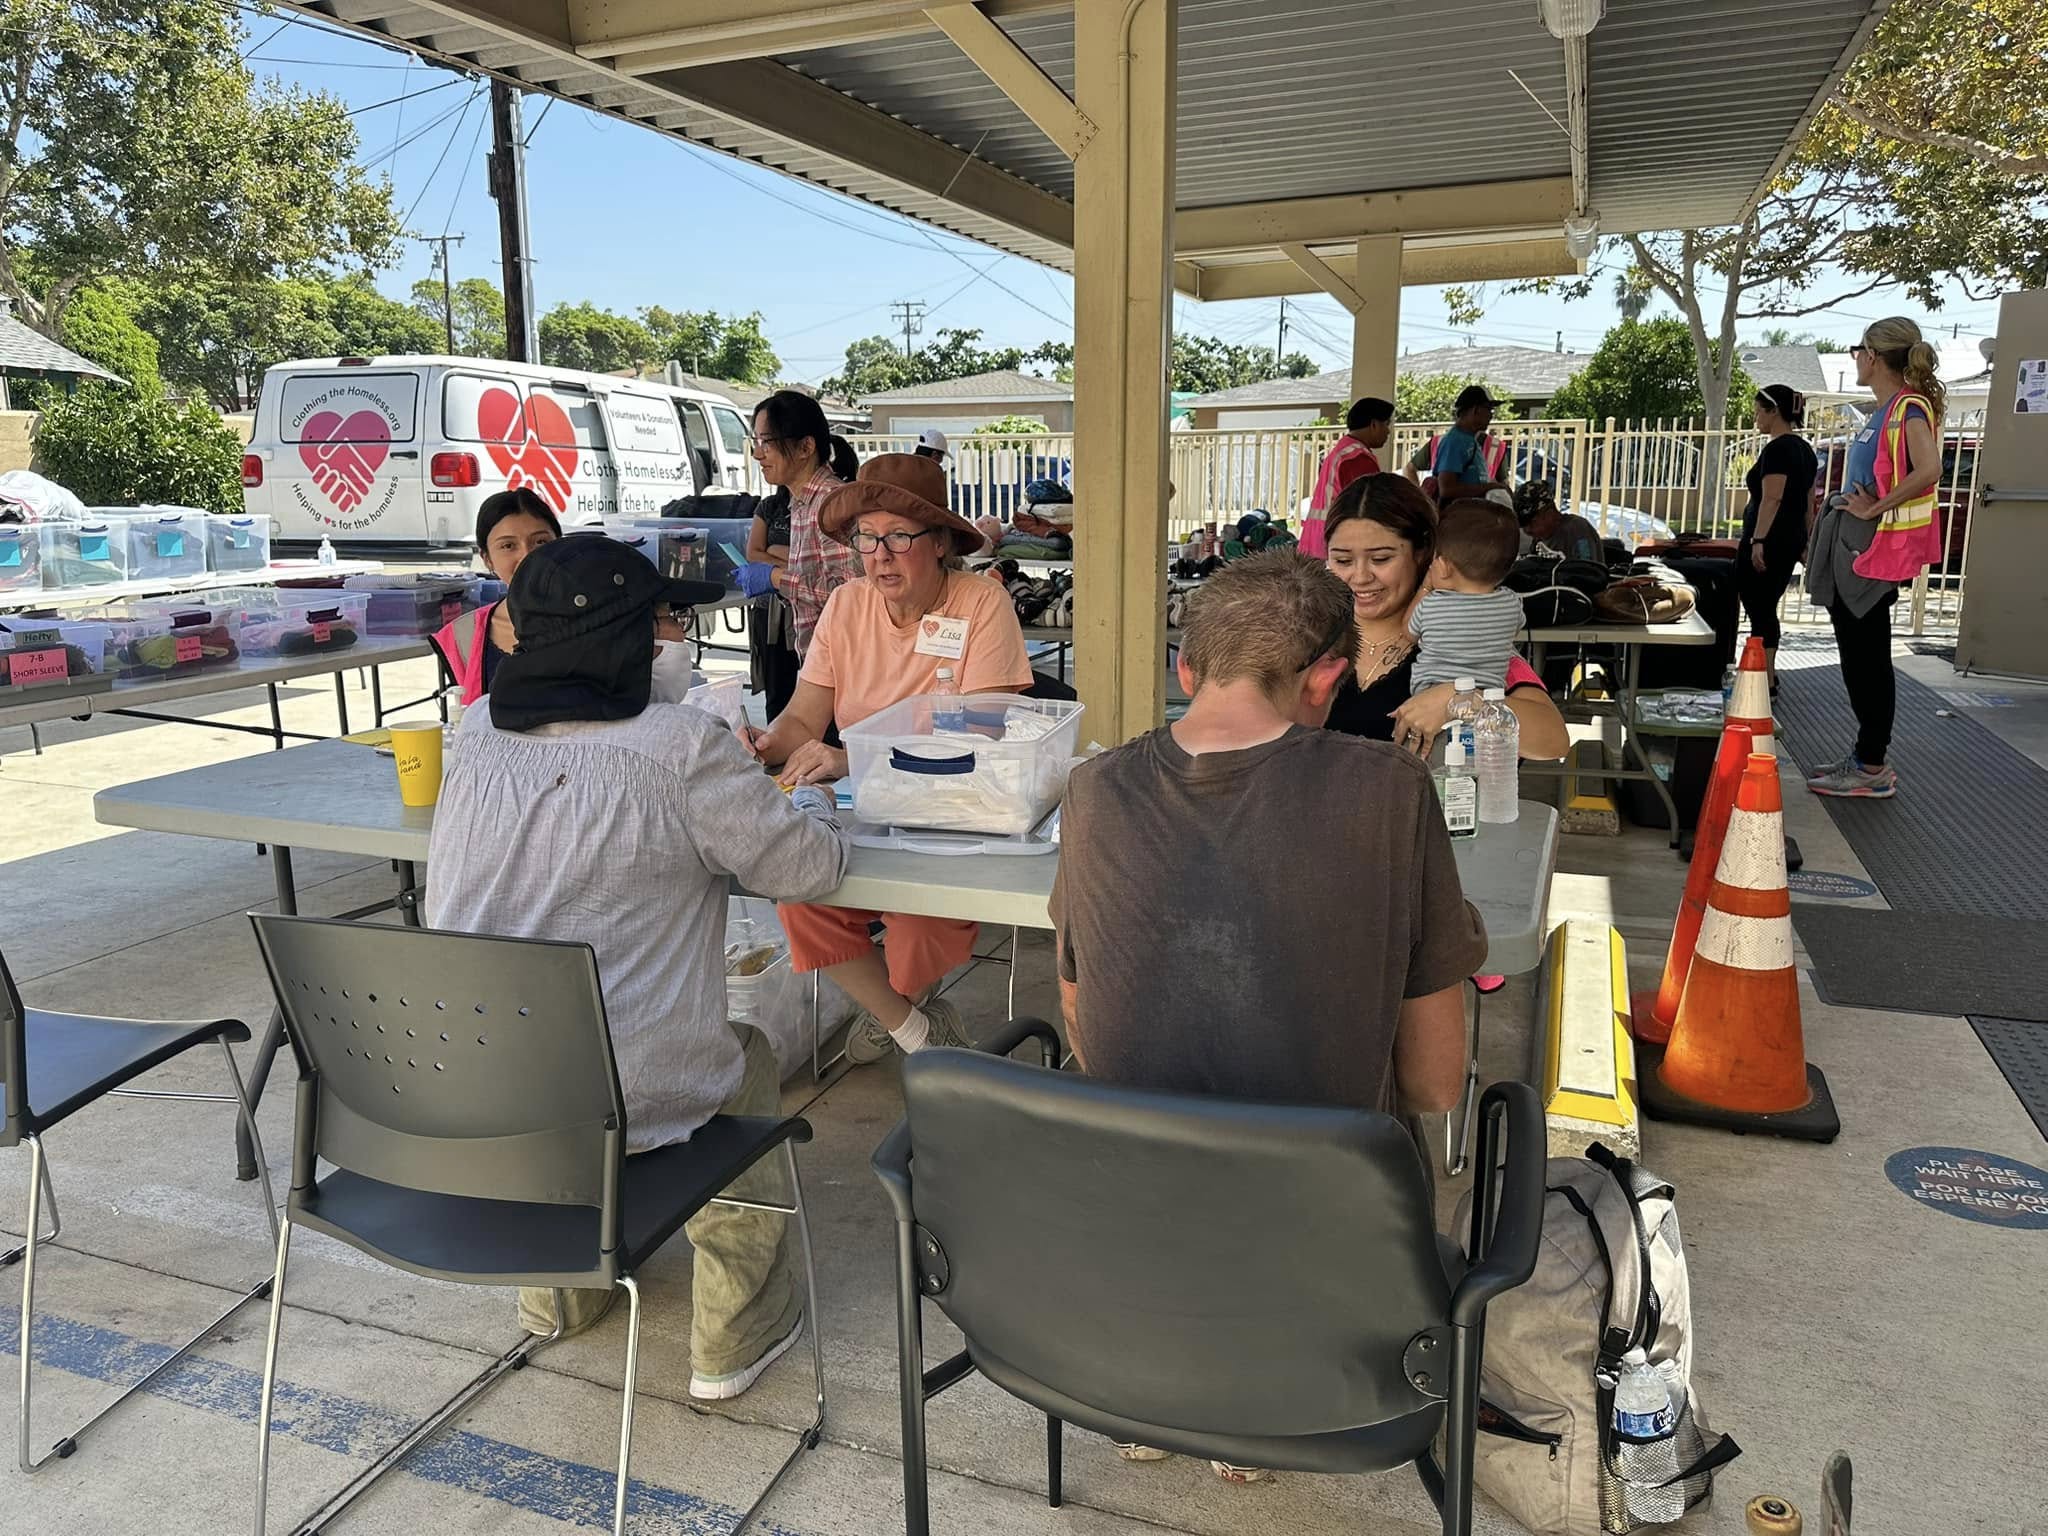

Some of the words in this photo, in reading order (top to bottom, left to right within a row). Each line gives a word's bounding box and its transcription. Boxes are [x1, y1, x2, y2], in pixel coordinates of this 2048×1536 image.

[292, 393, 327, 428] Clothing
[329, 387, 345, 398] the
[347, 386, 401, 432] Homeless.org
[609, 408, 641, 422] Volunteers
[634, 425, 656, 435] Needed
[292, 482, 322, 522] Helping
[339, 519, 352, 530] for
[354, 517, 370, 530] the
[369, 475, 399, 522] homeless
[625, 494, 641, 511] the
[24, 631, 52, 642] Hefty
[940, 627, 962, 641] Lisa
[13, 668, 38, 678] SHORT
[40, 665, 65, 675] SLEEVE
[1929, 1159, 2021, 1178] PLEASE
[1914, 1166, 1971, 1179] WAIT
[1978, 1174, 2044, 1190] HERE
[1920, 1181, 1972, 1196] POR
[1913, 1189, 2009, 1209] ESPERE
